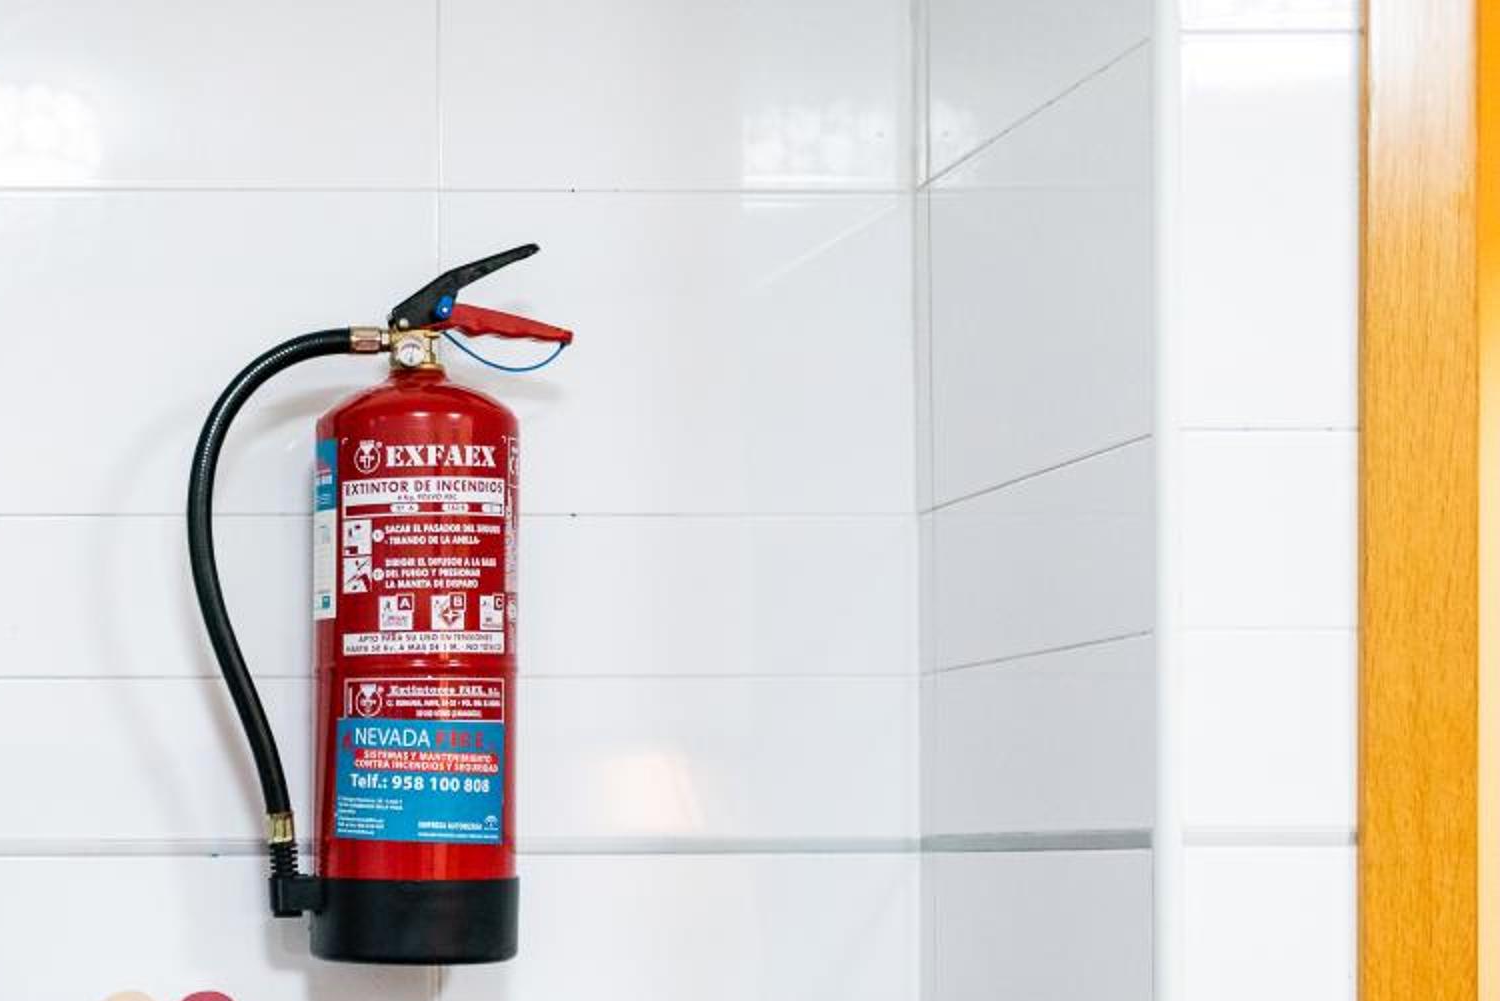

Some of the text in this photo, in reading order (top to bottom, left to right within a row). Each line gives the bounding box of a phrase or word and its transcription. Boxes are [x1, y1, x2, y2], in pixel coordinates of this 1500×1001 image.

[385, 445, 497, 468] EXFAEX
[345, 479, 503, 497] EXTINTOR DE INCENDIOS
[413, 525, 422, 533] EL
[423, 524, 461, 533] PASADOR
[428, 536, 438, 544] DE
[441, 535, 451, 544] LA
[464, 558, 470, 566] A
[472, 558, 481, 567] LA
[385, 569, 400, 578] DEL
[401, 569, 428, 578] FUEGO
[431, 569, 437, 577] Y
[385, 580, 396, 589] LA
[433, 579, 443, 588] DE
[445, 579, 478, 588] DISPARO
[399, 597, 411, 609] A
[453, 597, 462, 608] B
[355, 727, 431, 748] NEVADA
[363, 750, 409, 761] SISTEMAS
[410, 751, 416, 760] Y
[355, 760, 390, 769] CONTRA
[391, 761, 445, 771] INCENDIOS
[446, 762, 453, 771] Y
[350, 773, 490, 793] Telf.: 958 100 808
